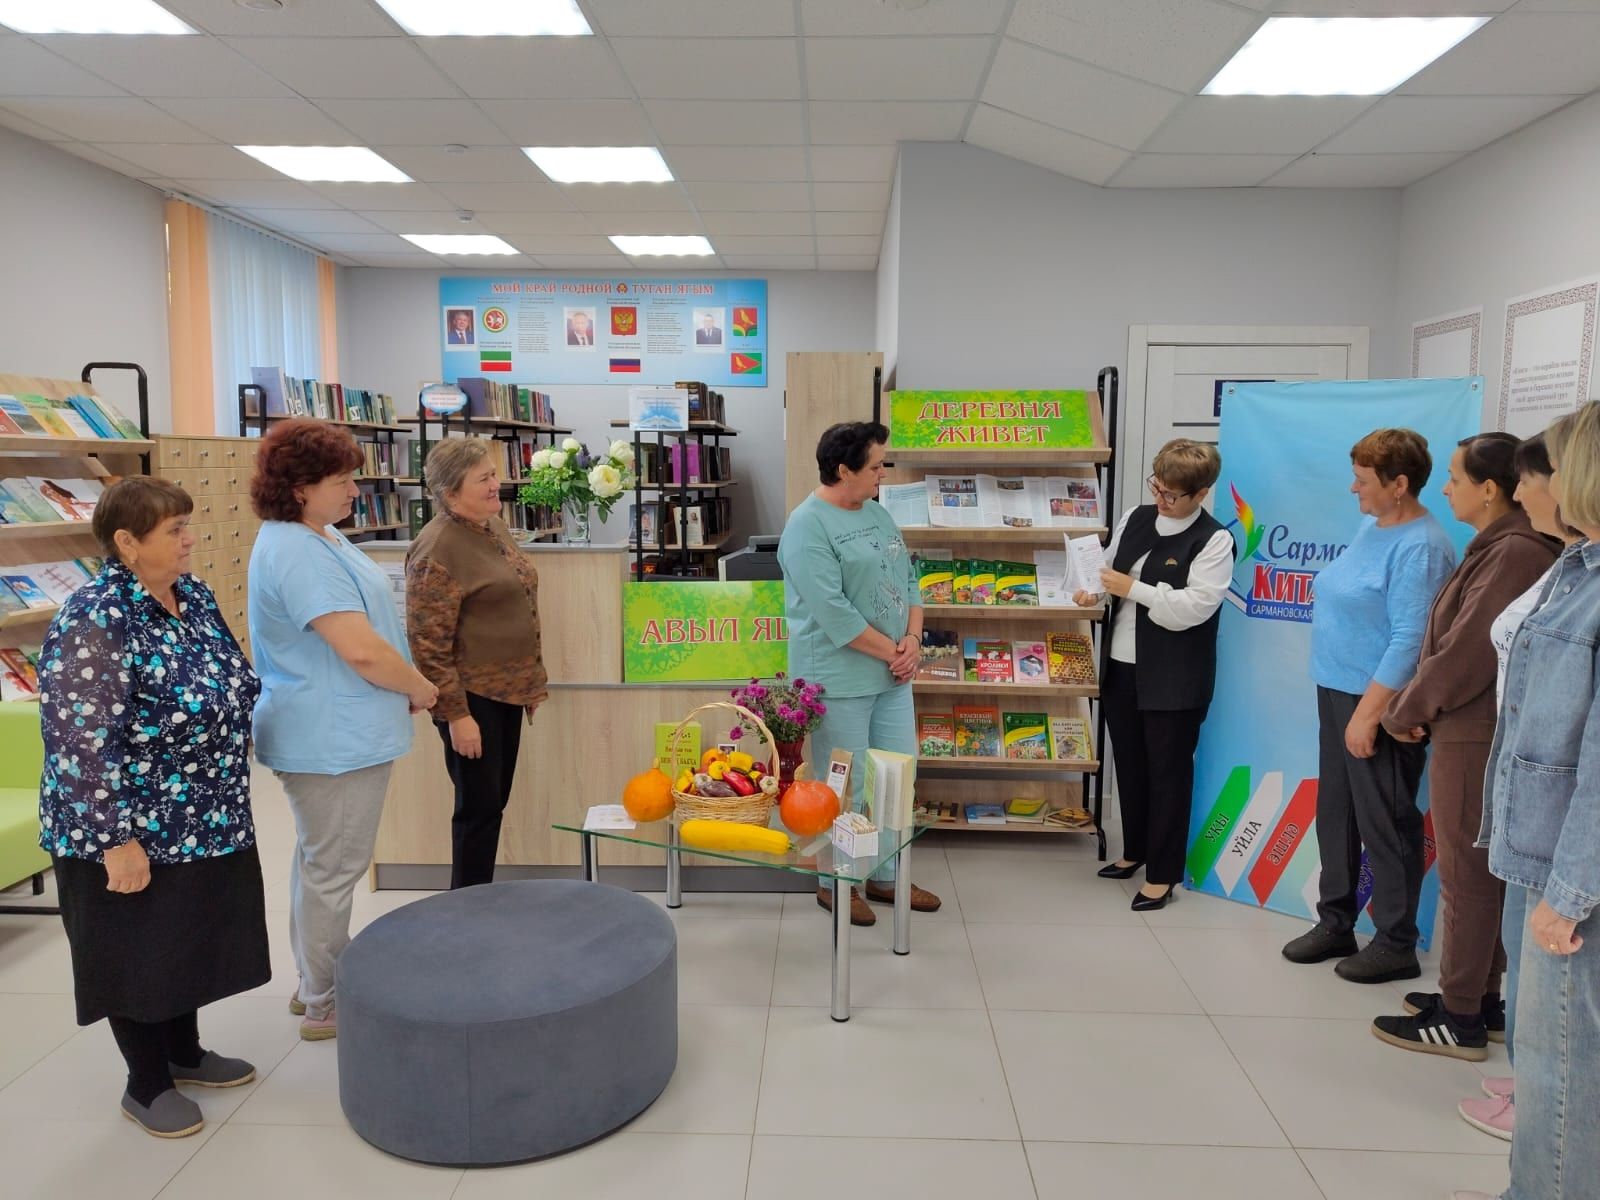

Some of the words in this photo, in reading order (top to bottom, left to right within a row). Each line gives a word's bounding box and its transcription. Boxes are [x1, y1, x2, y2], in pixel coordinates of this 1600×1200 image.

[525, 283, 556, 293] КРАЙ
[561, 283, 612, 294] РОДНОЙ
[631, 283, 673, 294] ТУГАН
[918, 402, 1062, 421] ДЕРЕВНЯ
[937, 425, 1049, 443] ЖИВЕТ
[640, 618, 740, 644] АВЫЛ
[1205, 812, 1230, 843] УКЫ
[1231, 821, 1262, 857] УЙЛА
